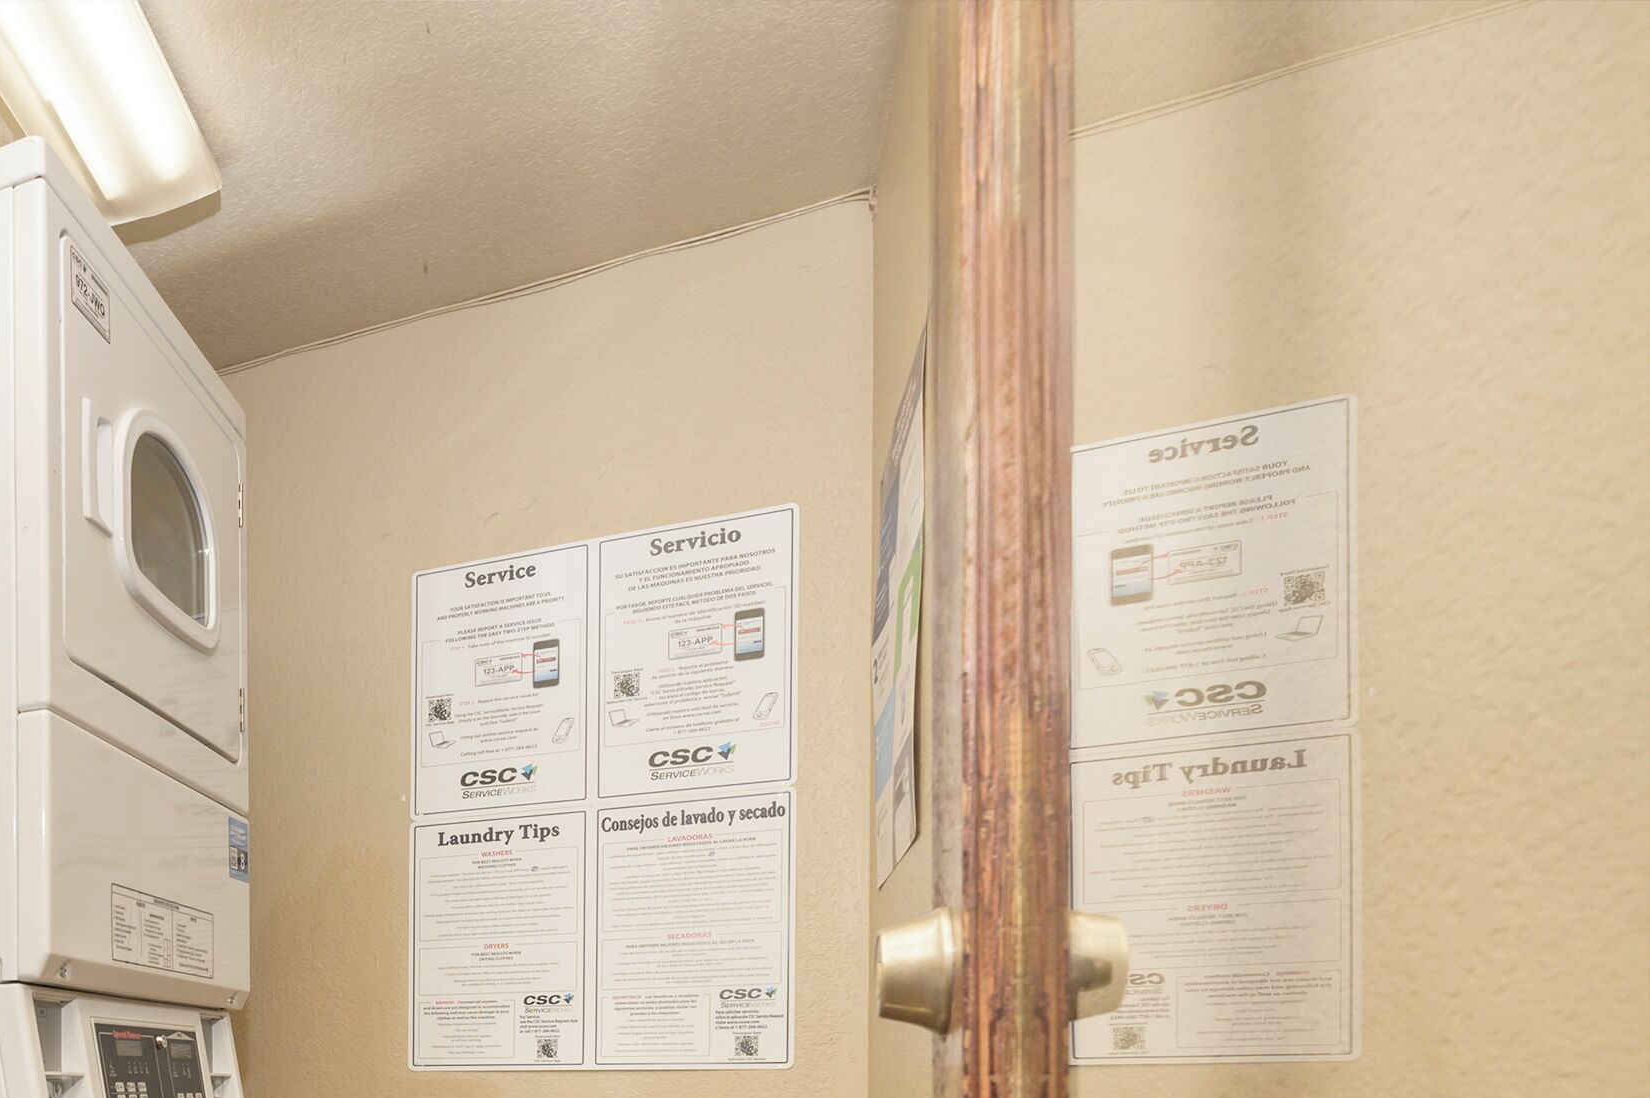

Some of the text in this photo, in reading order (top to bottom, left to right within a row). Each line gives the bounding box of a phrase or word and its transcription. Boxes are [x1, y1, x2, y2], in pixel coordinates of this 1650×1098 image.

[650, 528, 742, 555] Servicio
[624, 566, 668, 578] SATISFACCION
[678, 558, 719, 569] IMPORTANTE
[739, 548, 776, 559] NOSOTROS
[464, 564, 536, 587] Service
[650, 578, 684, 588] MAQUINAS
[694, 571, 724, 581] NUESTRA
[724, 566, 761, 576] PRIORIDAD
[464, 600, 499, 610] SATISFACTION
[505, 595, 535, 603] IMPORTANT
[445, 634, 477, 643] FOLLOWING
[503, 626, 530, 635] TWO-STEP
[678, 636, 713, 648] 123-APP
[648, 746, 713, 766] CSC
[460, 767, 518, 786] CSC
[601, 801, 786, 834] Consejos de lavado y secado
[438, 824, 560, 846] Laundry Tips
[667, 833, 713, 843] LAVADORAS
[240, 854, 245, 870] 8
[482, 850, 513, 858] WASHERS
[667, 932, 712, 940] SECADORAS
[524, 994, 561, 1006] CSC
[719, 988, 762, 1000] CSC
